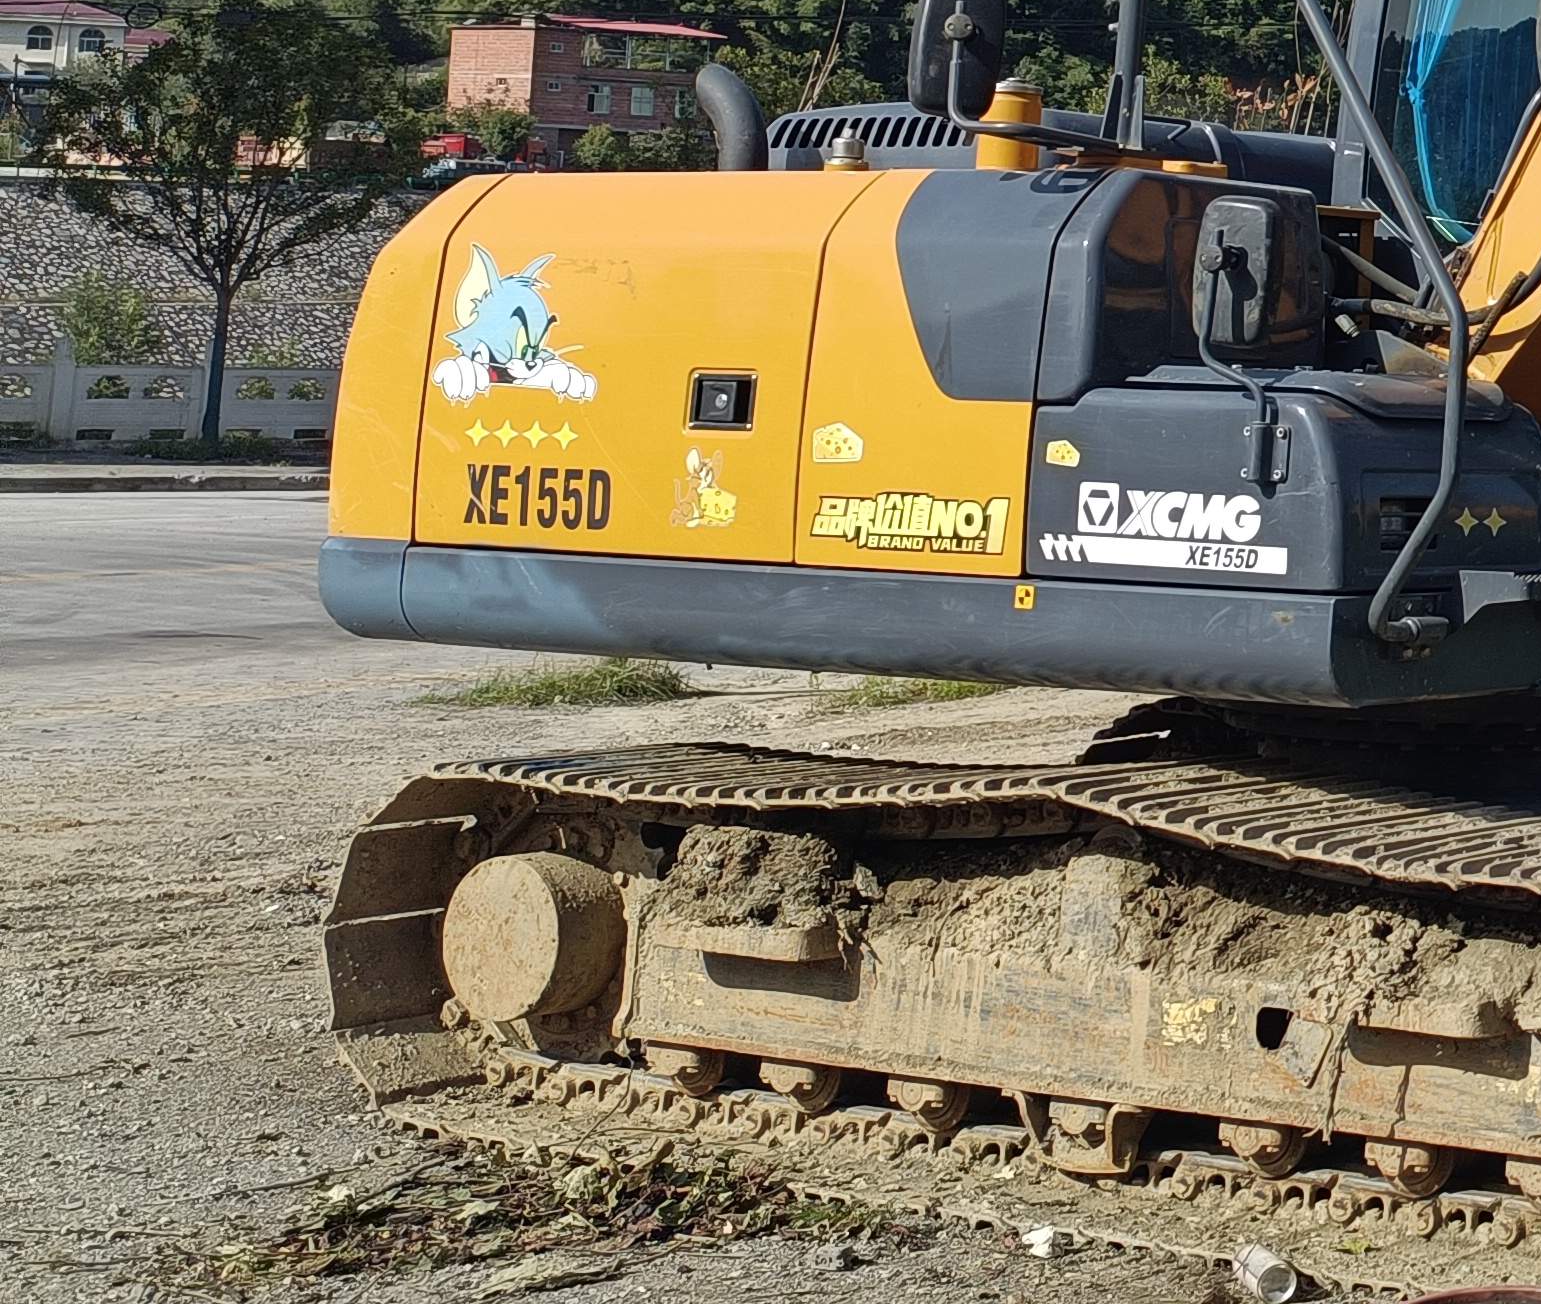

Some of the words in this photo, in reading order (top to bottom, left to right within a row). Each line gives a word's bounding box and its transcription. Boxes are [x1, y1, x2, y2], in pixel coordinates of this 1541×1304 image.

[464, 464, 611, 530] XE155D
[1116, 489, 1262, 543] XCMG
[867, 535, 925, 551] BRAND
[930, 537, 985, 553] VALUE
[1185, 545, 1259, 569] XE155D
